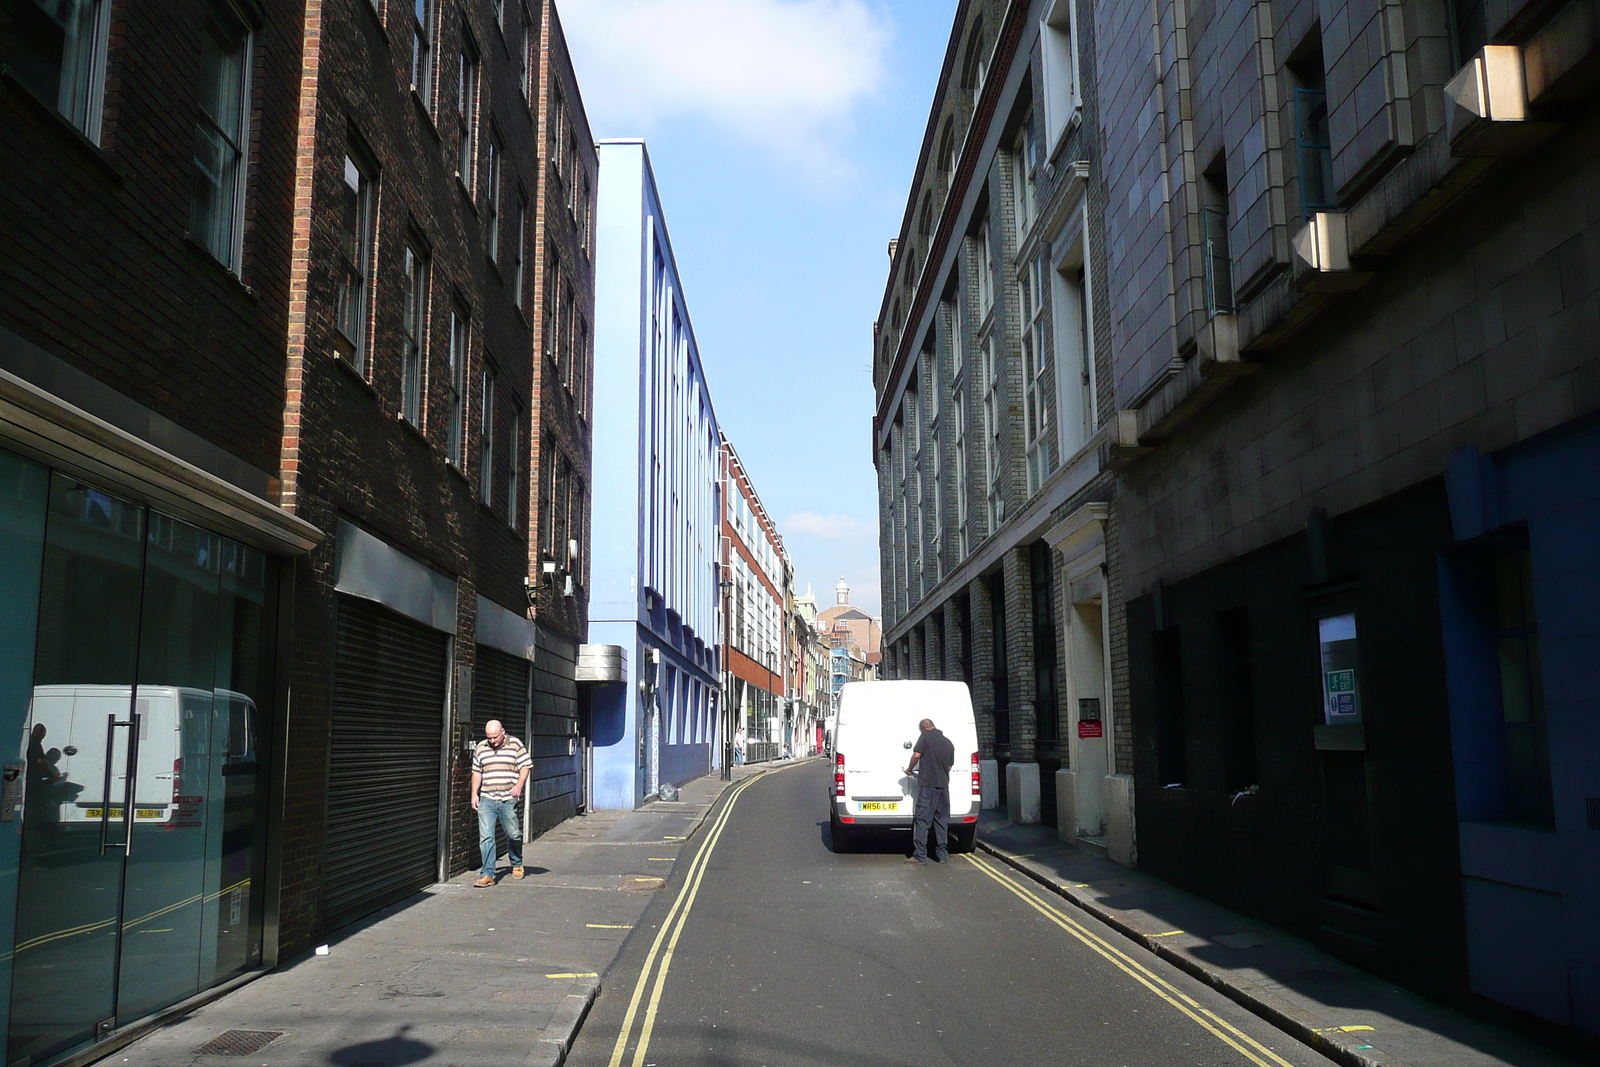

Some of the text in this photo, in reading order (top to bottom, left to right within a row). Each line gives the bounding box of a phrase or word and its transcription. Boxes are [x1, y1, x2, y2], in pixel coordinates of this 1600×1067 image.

[1340, 672, 1351, 682] FIRE
[1341, 682, 1351, 690] EXIT
[1341, 704, 1353, 712] CLEAR
